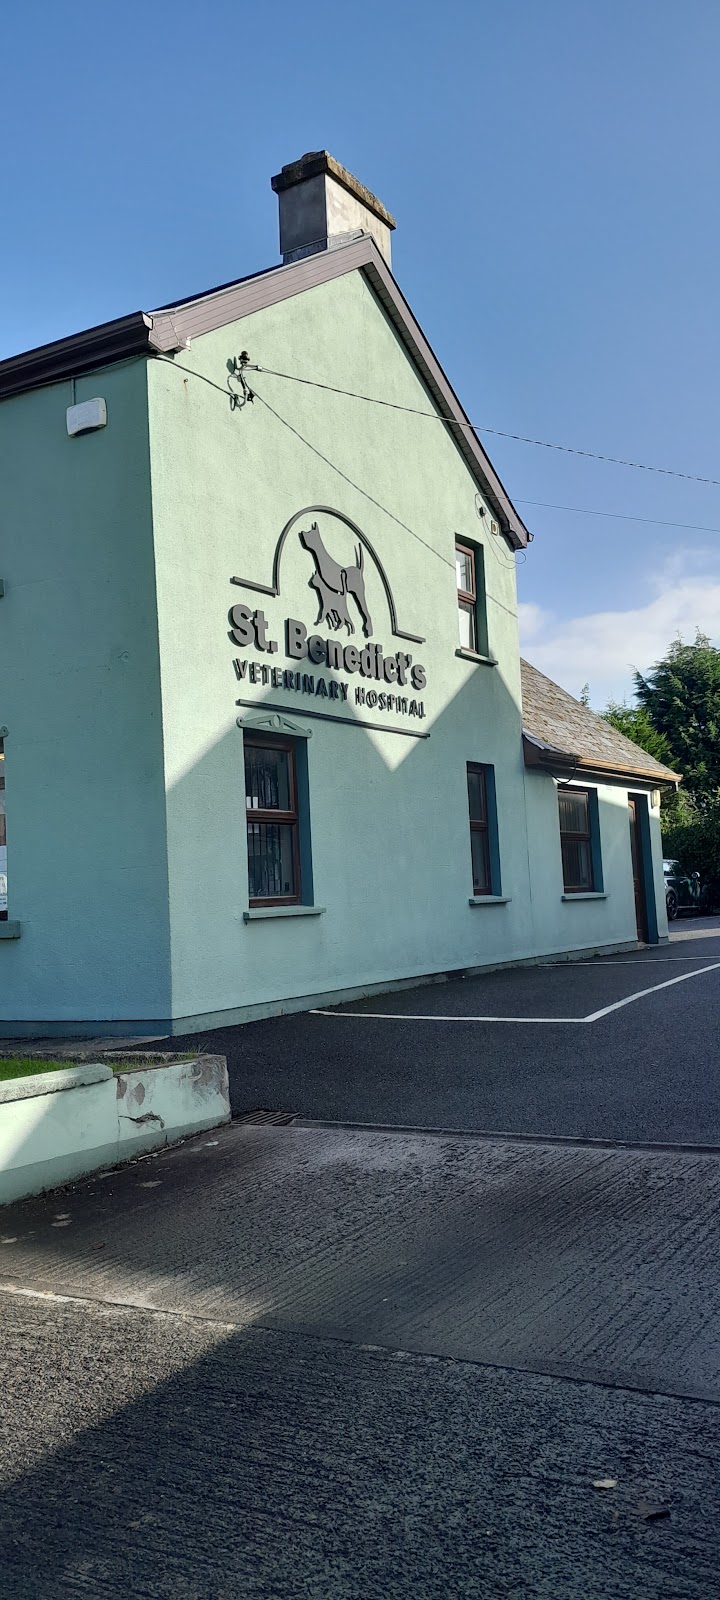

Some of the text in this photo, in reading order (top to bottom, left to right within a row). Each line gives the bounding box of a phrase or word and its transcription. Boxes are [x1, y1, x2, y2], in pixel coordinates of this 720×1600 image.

[228, 604, 427, 690] St. Benedict's
[233, 658, 426, 719] VETERINARY HOSPITAL
